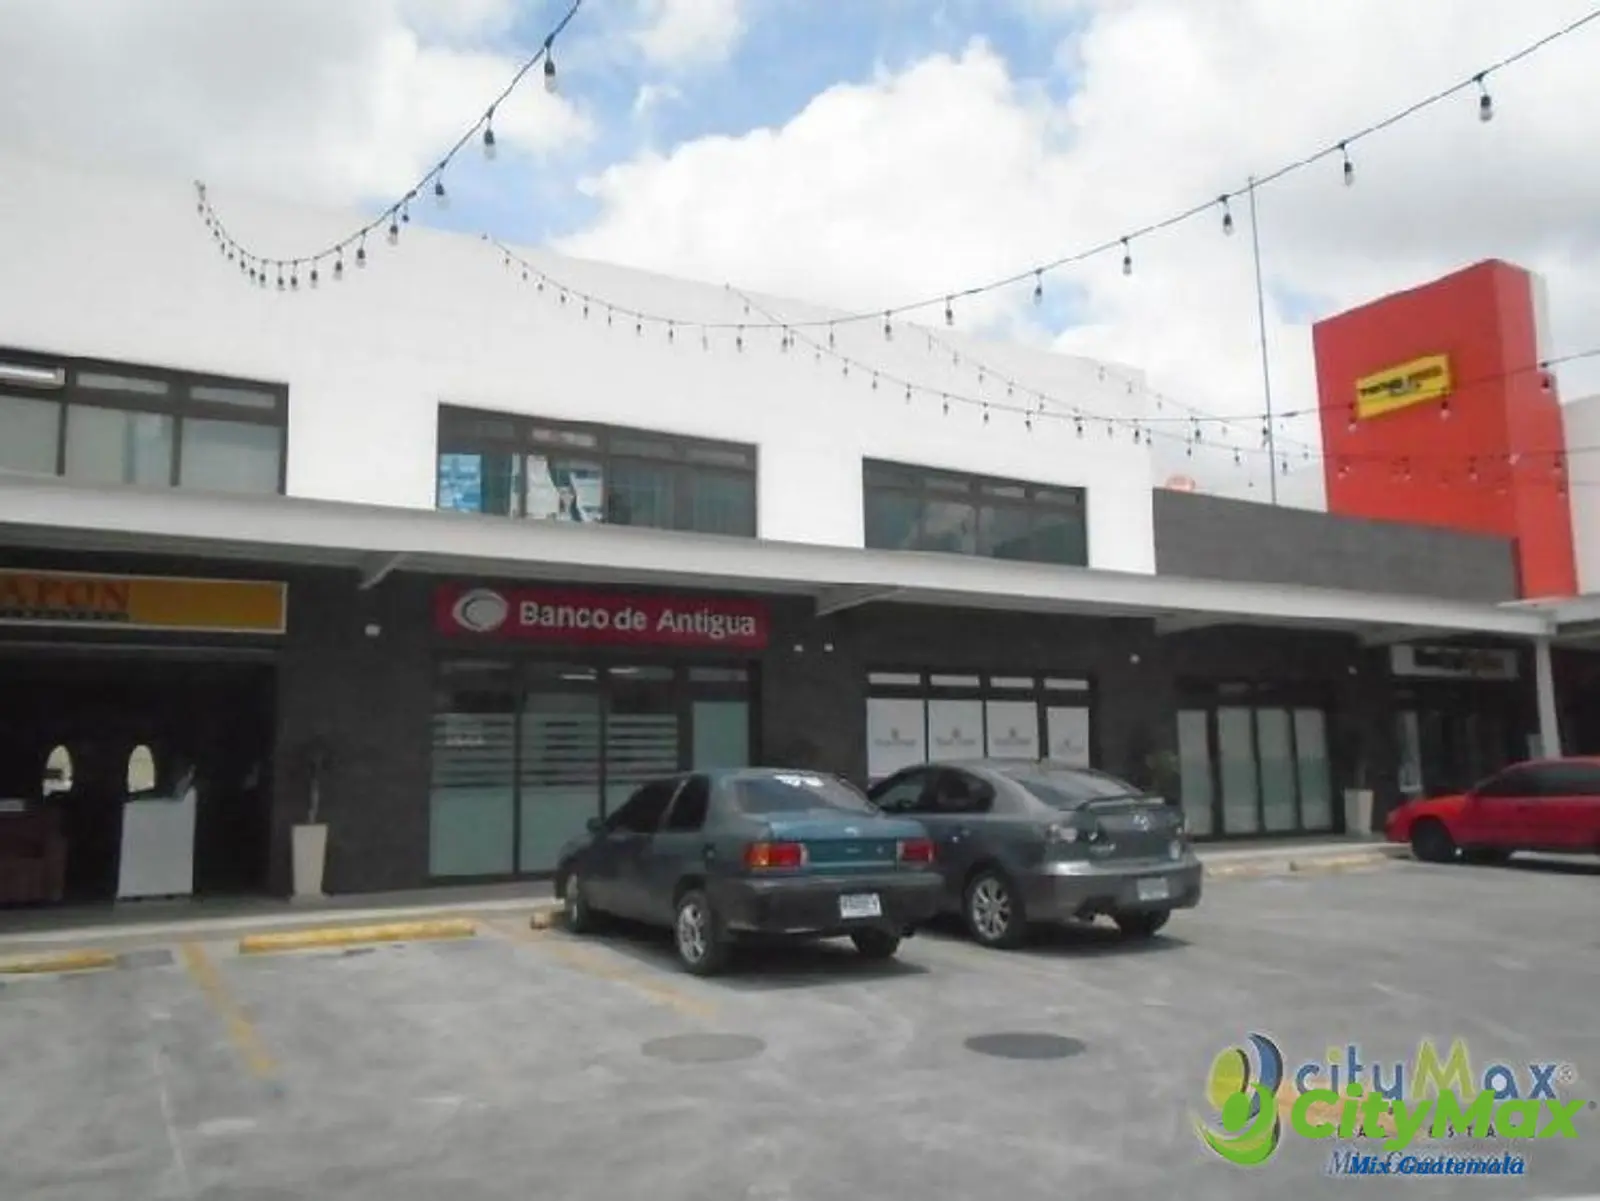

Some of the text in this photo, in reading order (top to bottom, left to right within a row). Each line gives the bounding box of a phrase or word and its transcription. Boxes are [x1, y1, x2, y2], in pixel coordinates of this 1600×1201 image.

[519, 600, 757, 640] Banco de Antigua
